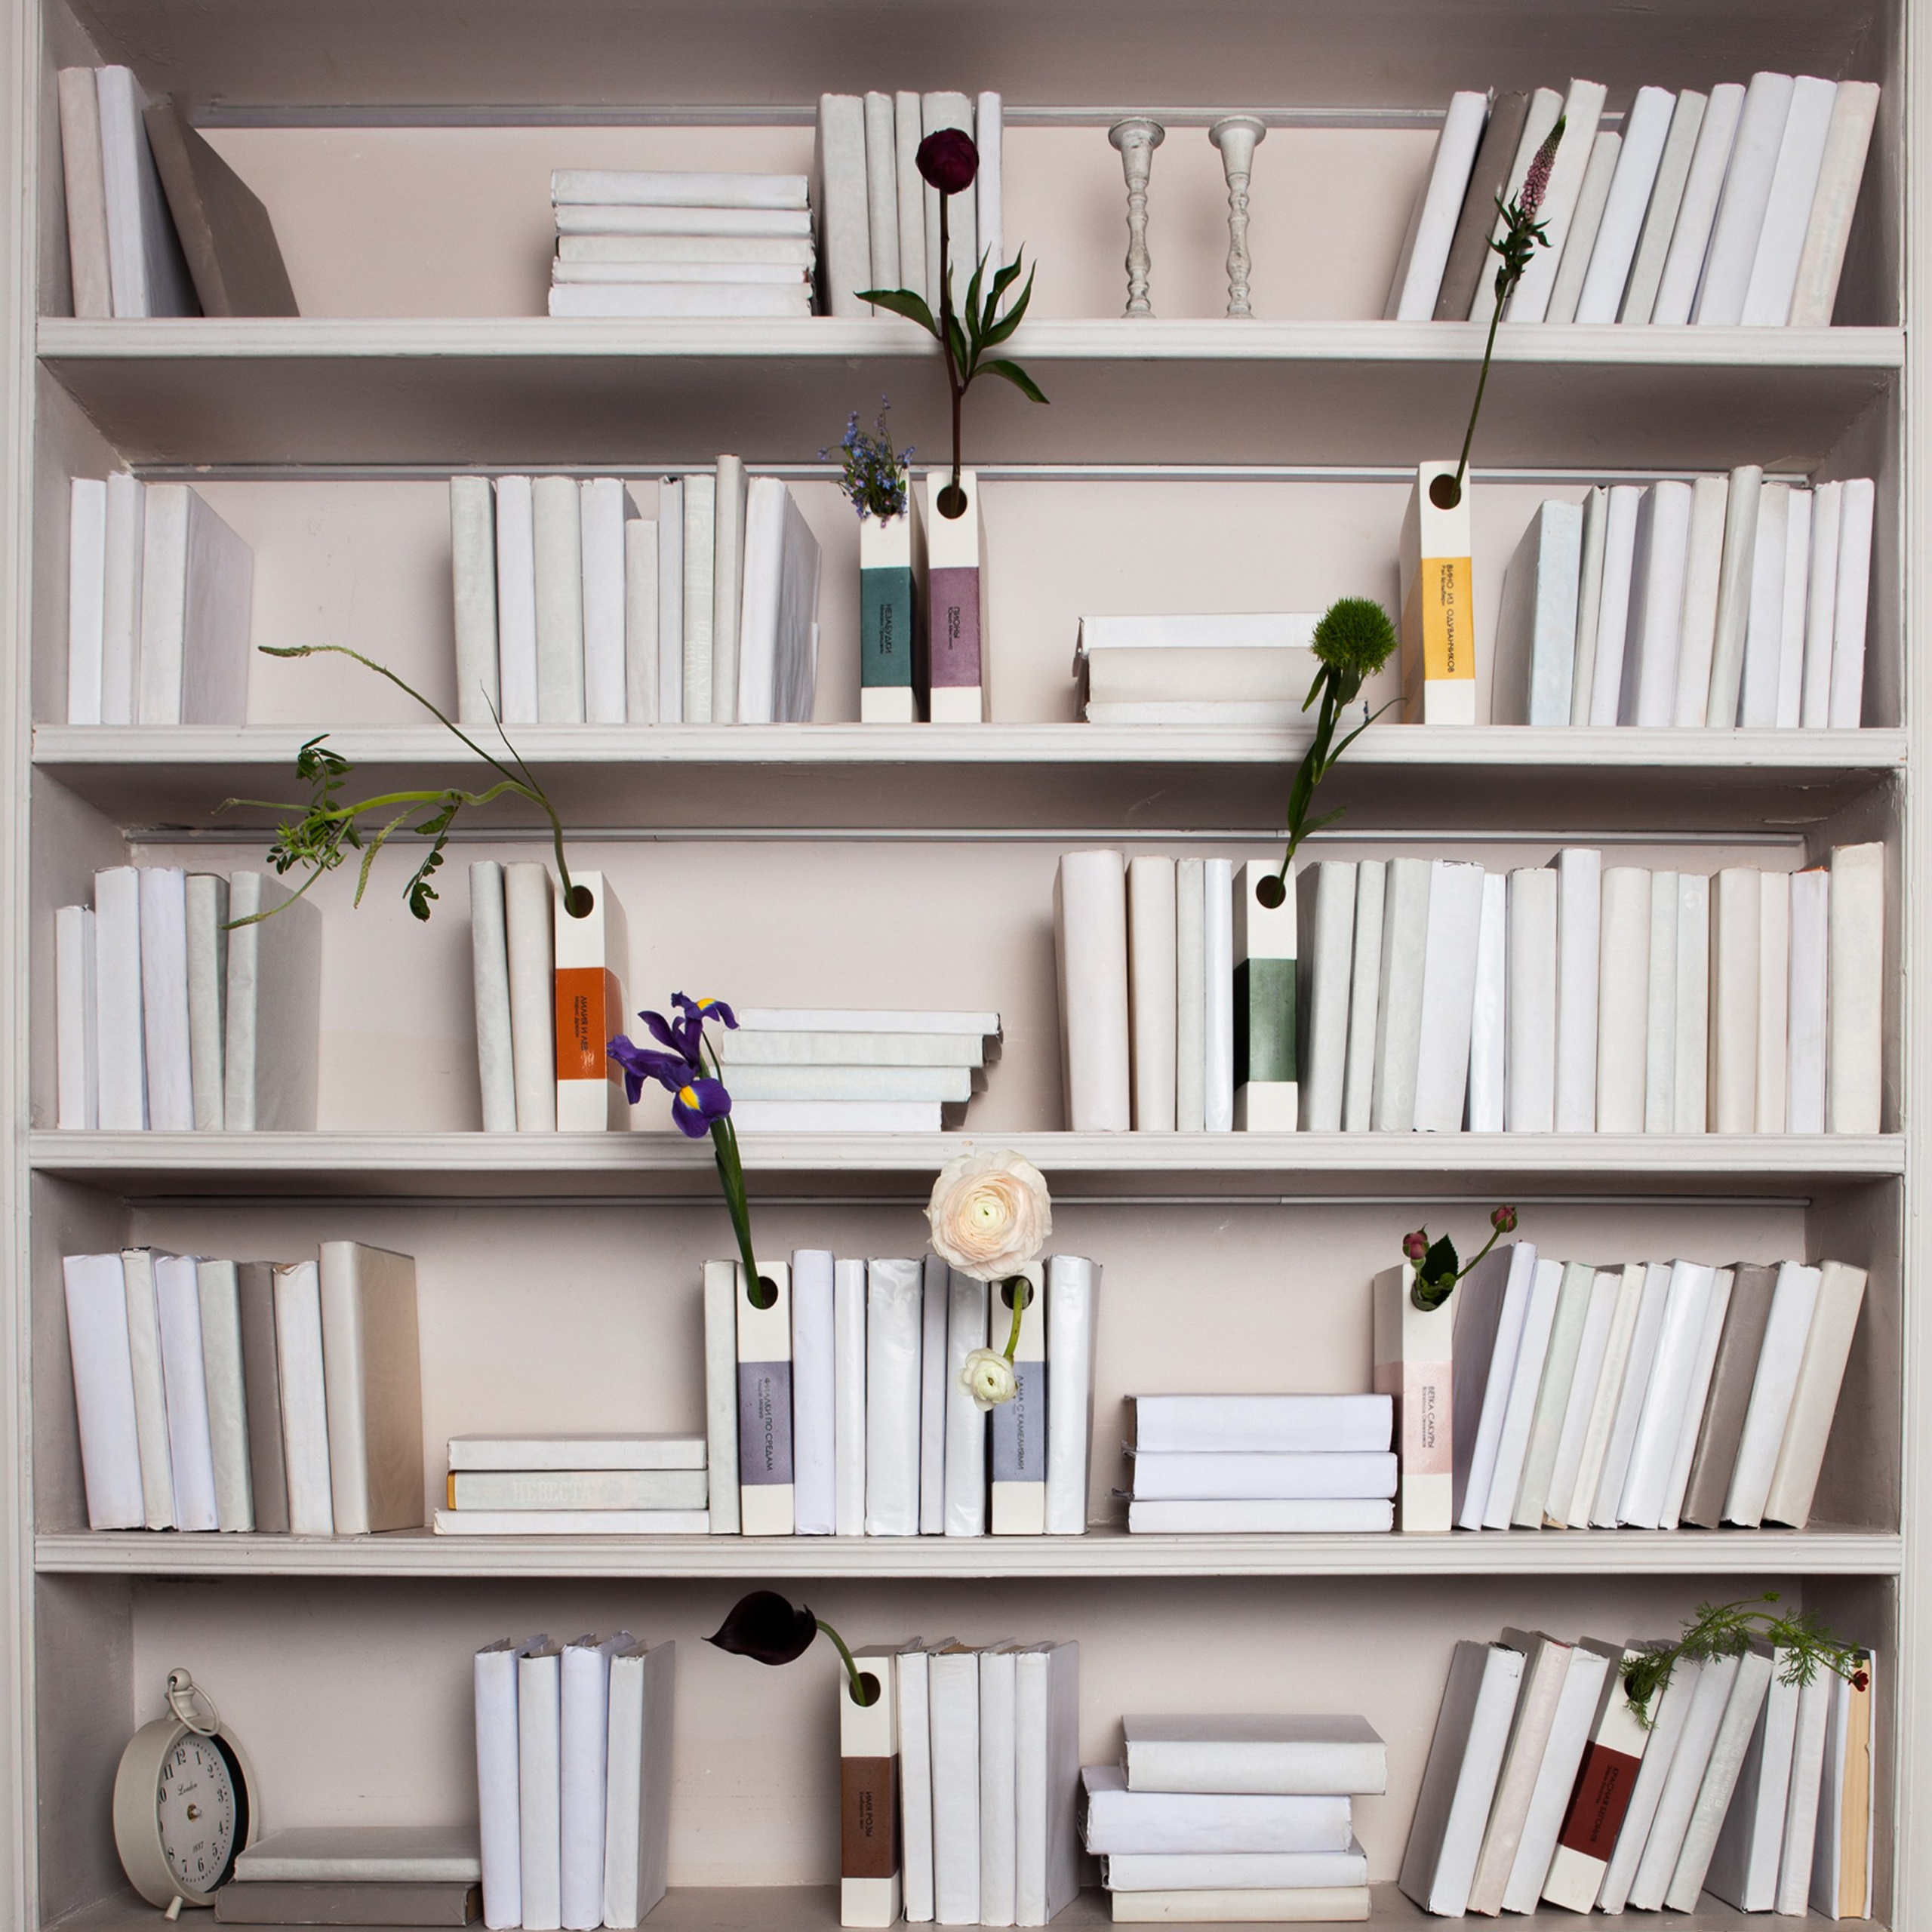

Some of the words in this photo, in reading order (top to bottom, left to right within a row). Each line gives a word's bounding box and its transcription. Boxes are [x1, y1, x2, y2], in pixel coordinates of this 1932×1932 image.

[1446, 593, 1454, 605] ИЗ
[1446, 609, 1454, 673] ОДУВАНЧИКОВ
[765, 1417, 772, 1431] ПО
[512, 1479, 595, 1503] НЕВЕСТА
[176, 1748, 186, 1766] 12
[195, 1751, 202, 1765] 1
[164, 1763, 174, 1781] 11
[207, 1764, 214, 1778] 2
[177, 1782, 198, 1796] London
[1603, 1767, 1619, 1806] КРАСНАЯ
[217, 1789, 224, 1802] 3
[218, 1820, 223, 1835] 4
[865, 1813, 873, 1837] РОЗЫ
[1590, 1806, 1607, 1842] БЕГОНИЯ
[168, 1846, 176, 1863] 8
[211, 1842, 218, 1857] 5
[181, 1859, 188, 1873] 7
[197, 1858, 205, 1872] 6
